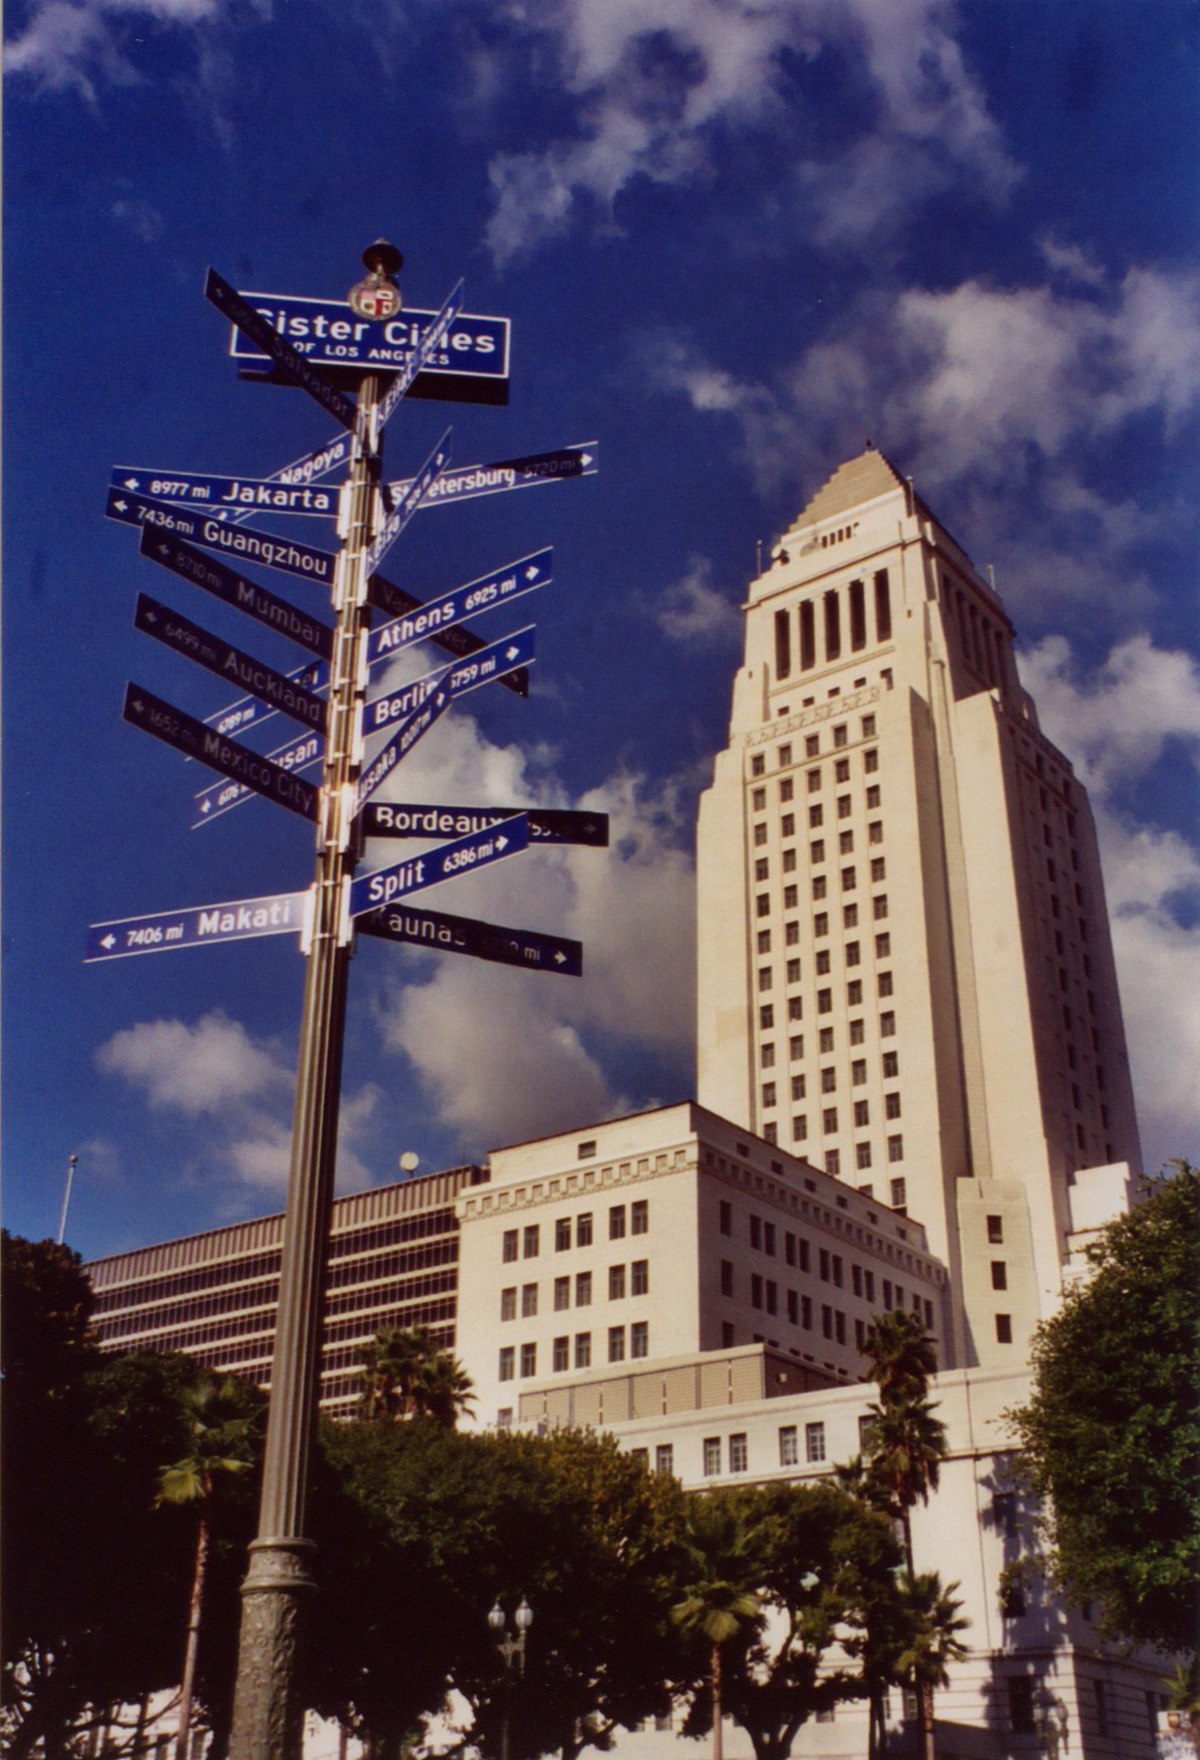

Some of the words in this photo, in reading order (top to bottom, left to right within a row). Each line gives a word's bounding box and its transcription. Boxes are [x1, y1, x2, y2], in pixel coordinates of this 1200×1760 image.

[292, 340, 316, 354] OF
[325, 343, 359, 358] LOS
[368, 347, 450, 366] ANGEES
[384, 320, 495, 353] Ciies
[272, 335, 349, 418] Salvador
[280, 443, 345, 484] Nagoya
[429, 468, 516, 498] etersburg
[559, 459, 577, 471] mi
[149, 480, 188, 497] 8977
[192, 485, 211, 499] mi
[221, 482, 330, 510] Jakarta
[137, 505, 174, 530] 7436
[176, 519, 195, 535] mi
[203, 521, 328, 576] Guangzhou
[206, 570, 224, 588] mi
[236, 580, 321, 647] Mumbai
[377, 601, 456, 653] Athens
[464, 583, 498, 611] 6925
[500, 574, 517, 595] mi
[201, 644, 218, 664] mi
[223, 651, 321, 722] Auckland
[480, 655, 496, 676] mi
[204, 733, 271, 787] Mexico
[276, 774, 314, 813] City
[269, 738, 318, 770] usan
[360, 745, 397, 800] usaka
[368, 859, 426, 902] Split
[442, 847, 477, 874] 6386
[477, 838, 494, 860] mi
[126, 926, 163, 948] 7406
[165, 923, 184, 941] mi
[198, 900, 290, 936] Makati
[523, 945, 541, 961] mi
